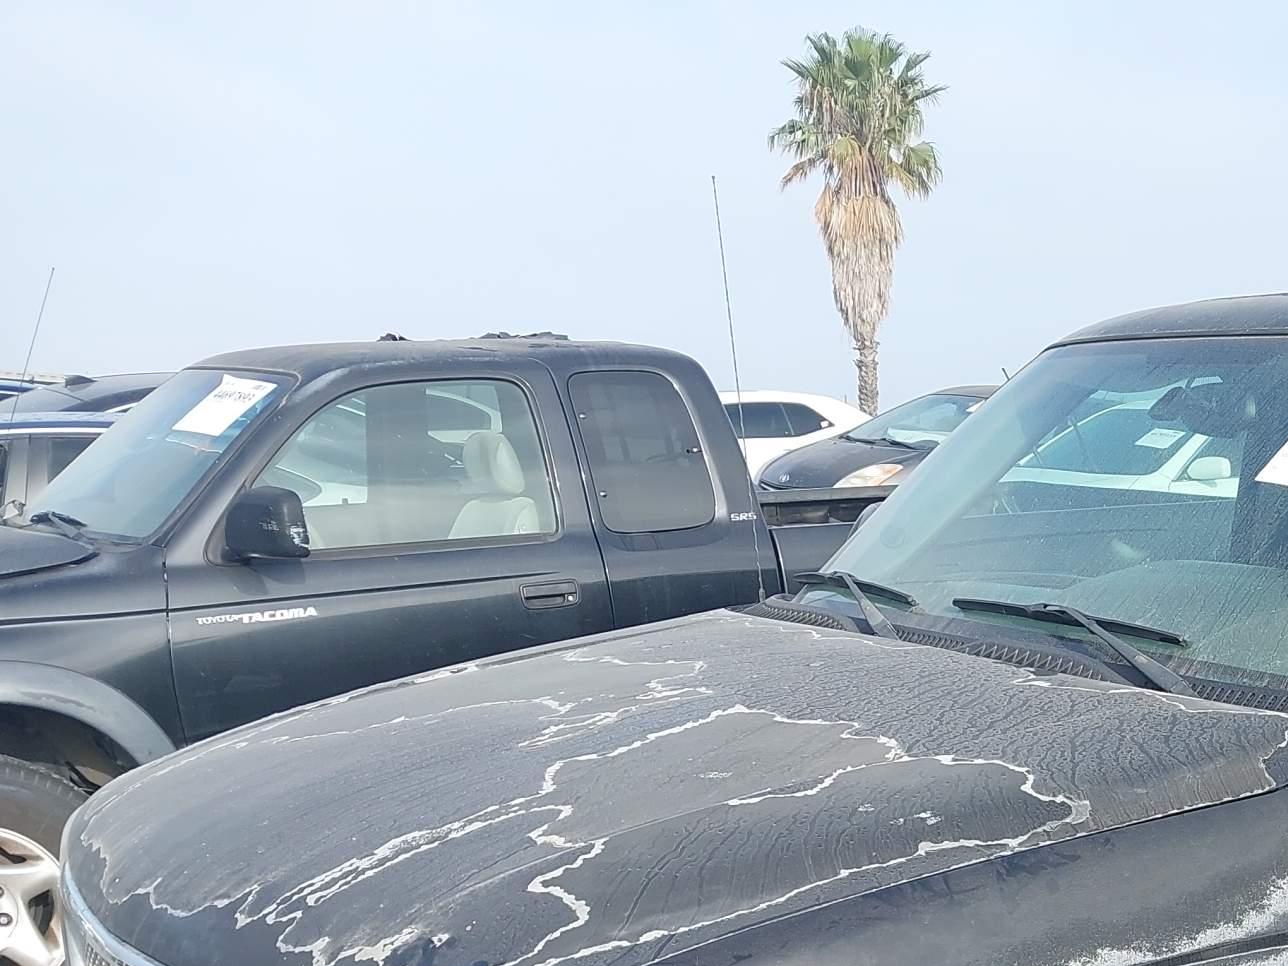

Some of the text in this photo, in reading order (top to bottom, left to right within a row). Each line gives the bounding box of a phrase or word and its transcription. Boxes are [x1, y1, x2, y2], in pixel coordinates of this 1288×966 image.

[730, 512, 757, 521] SR5
[195, 606, 317, 625] TOYOTA TACOMA
